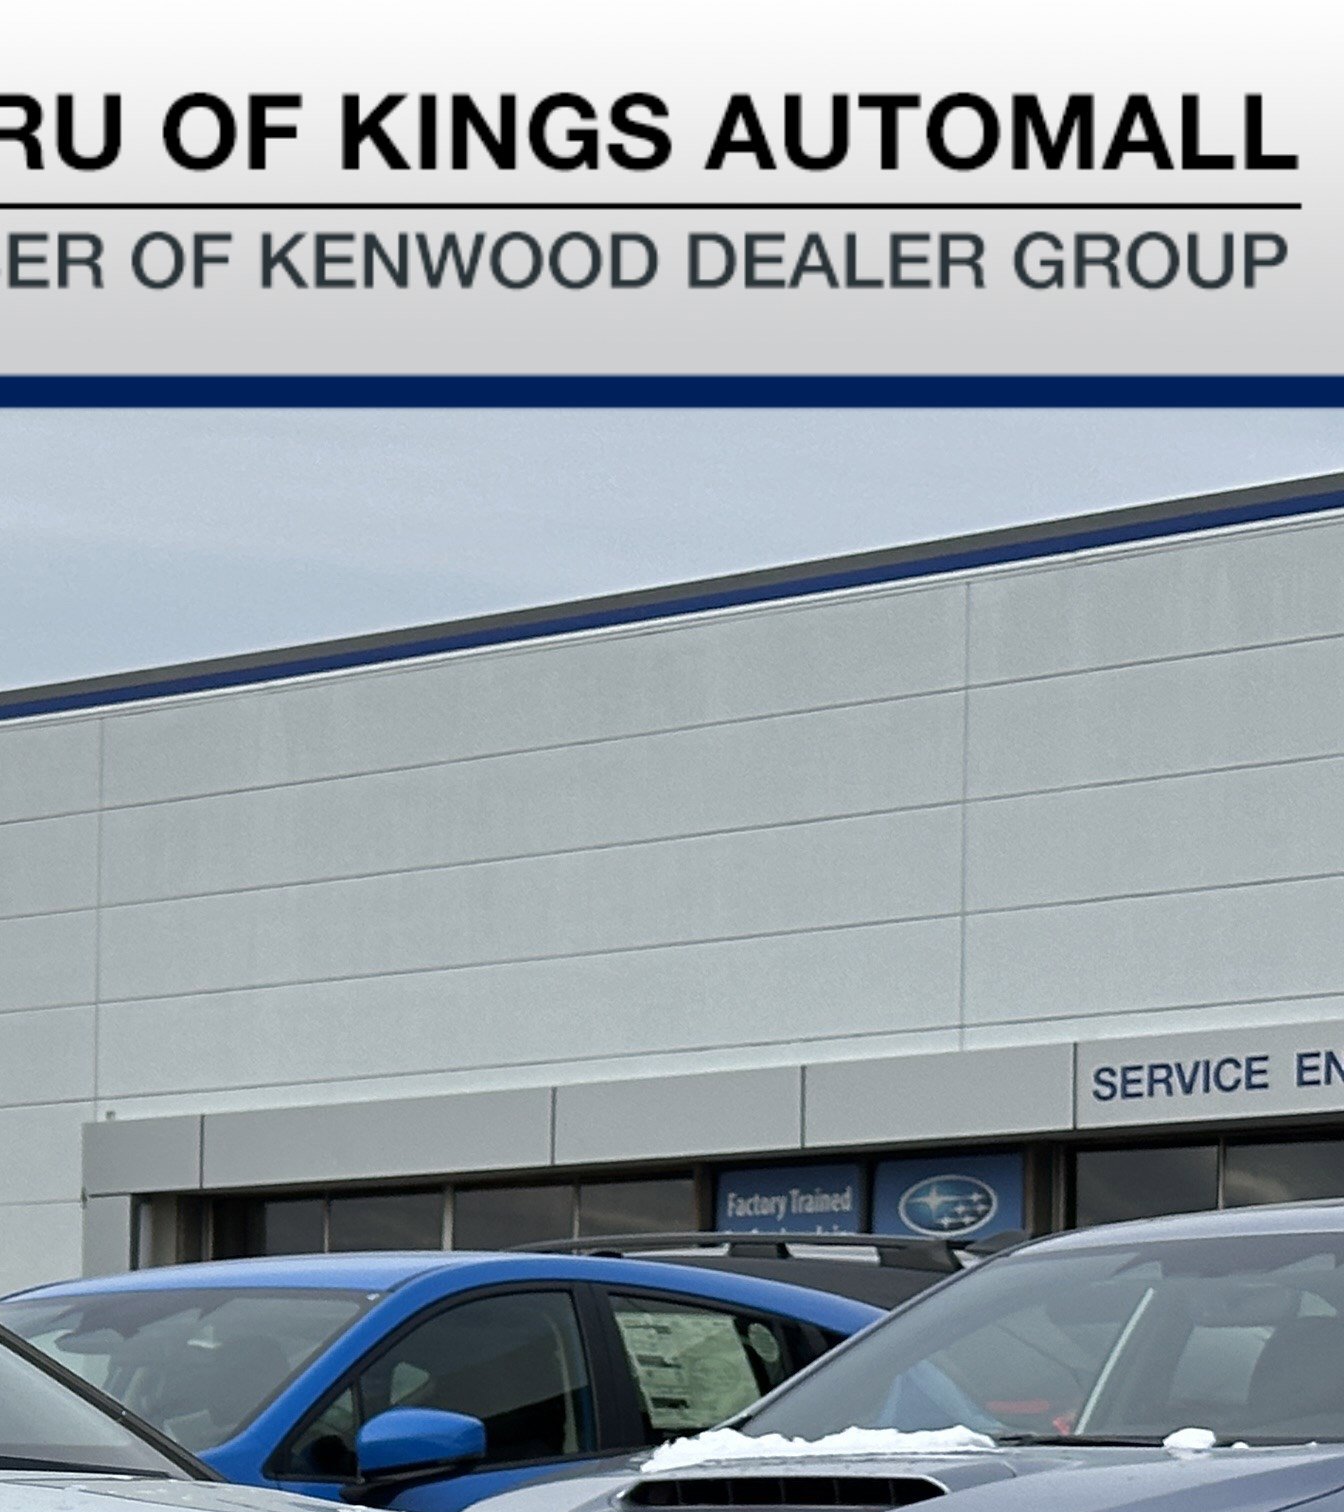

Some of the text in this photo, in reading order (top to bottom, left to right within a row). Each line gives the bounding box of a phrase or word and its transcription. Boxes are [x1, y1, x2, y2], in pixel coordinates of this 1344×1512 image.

[1092, 1055, 1270, 1101] SERVICE
[726, 1185, 852, 1222] Factory Trained
